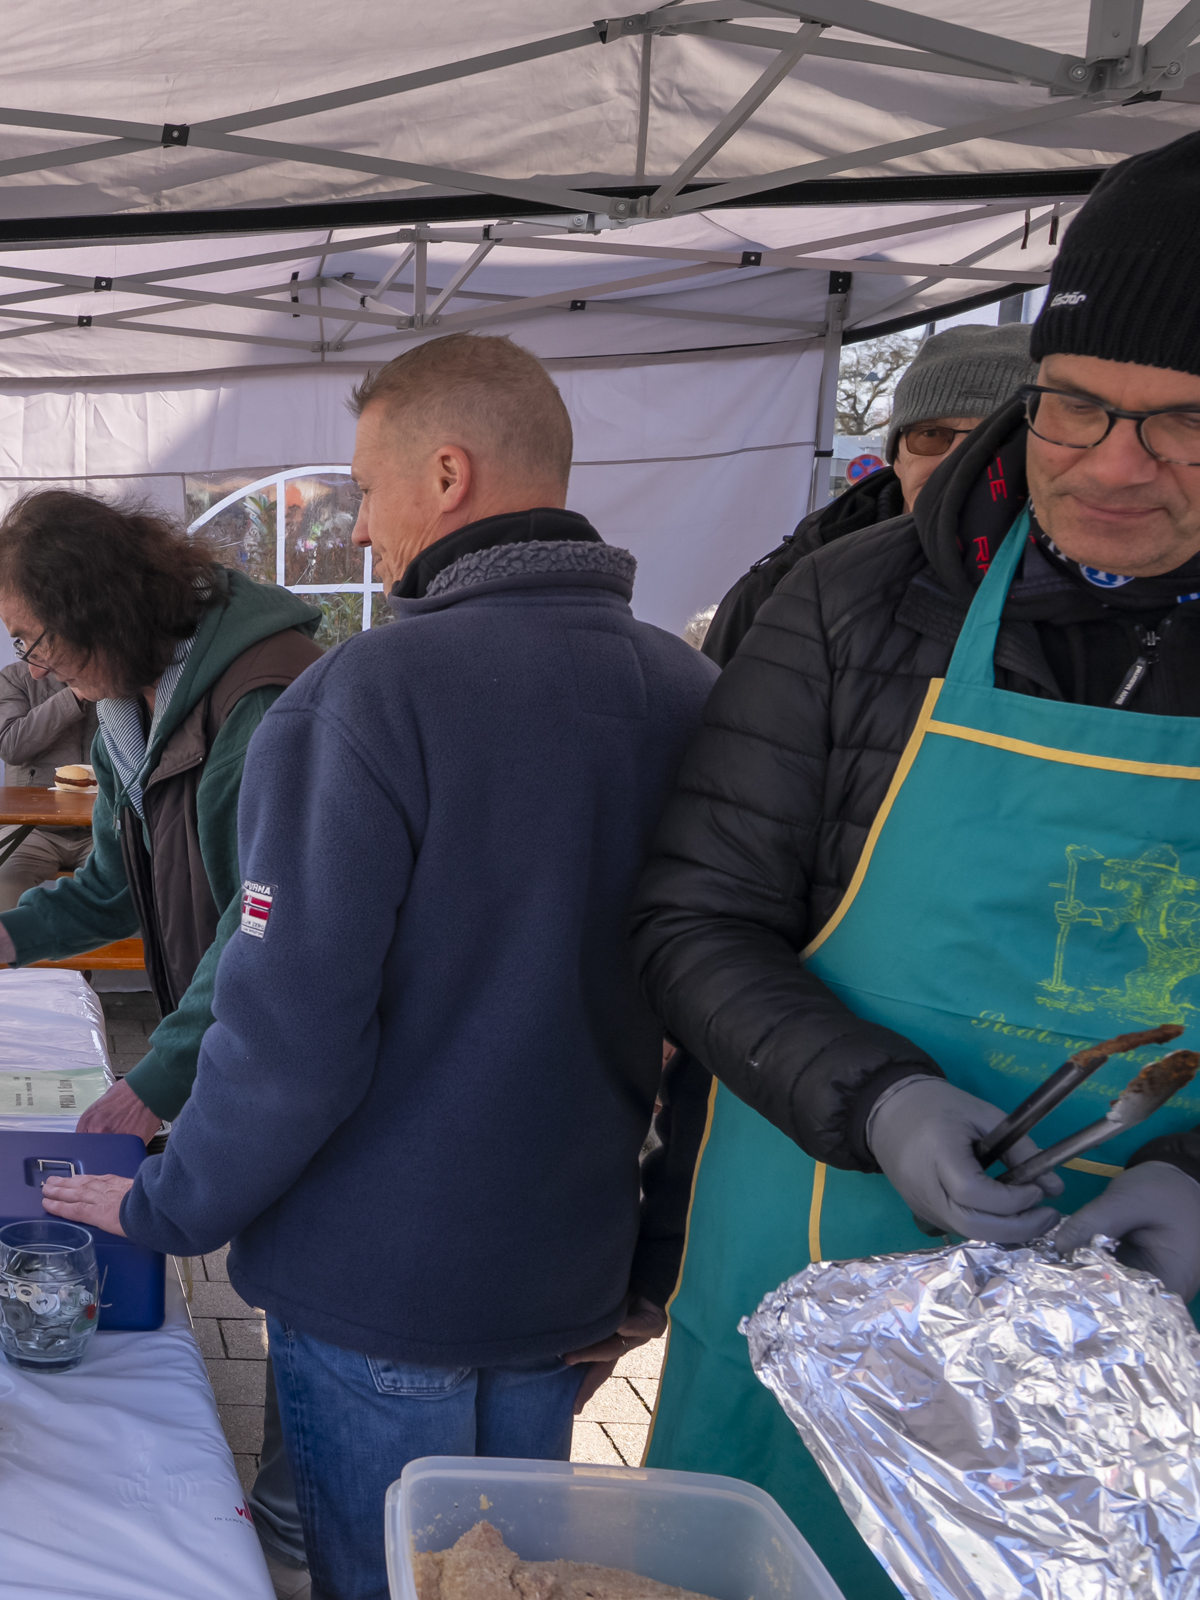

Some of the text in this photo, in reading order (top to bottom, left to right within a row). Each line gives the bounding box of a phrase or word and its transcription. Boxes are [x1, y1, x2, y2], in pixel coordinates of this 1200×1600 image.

[1115, 666, 1143, 705] BMW Motorrad
[244, 880, 271, 895] PURNA
